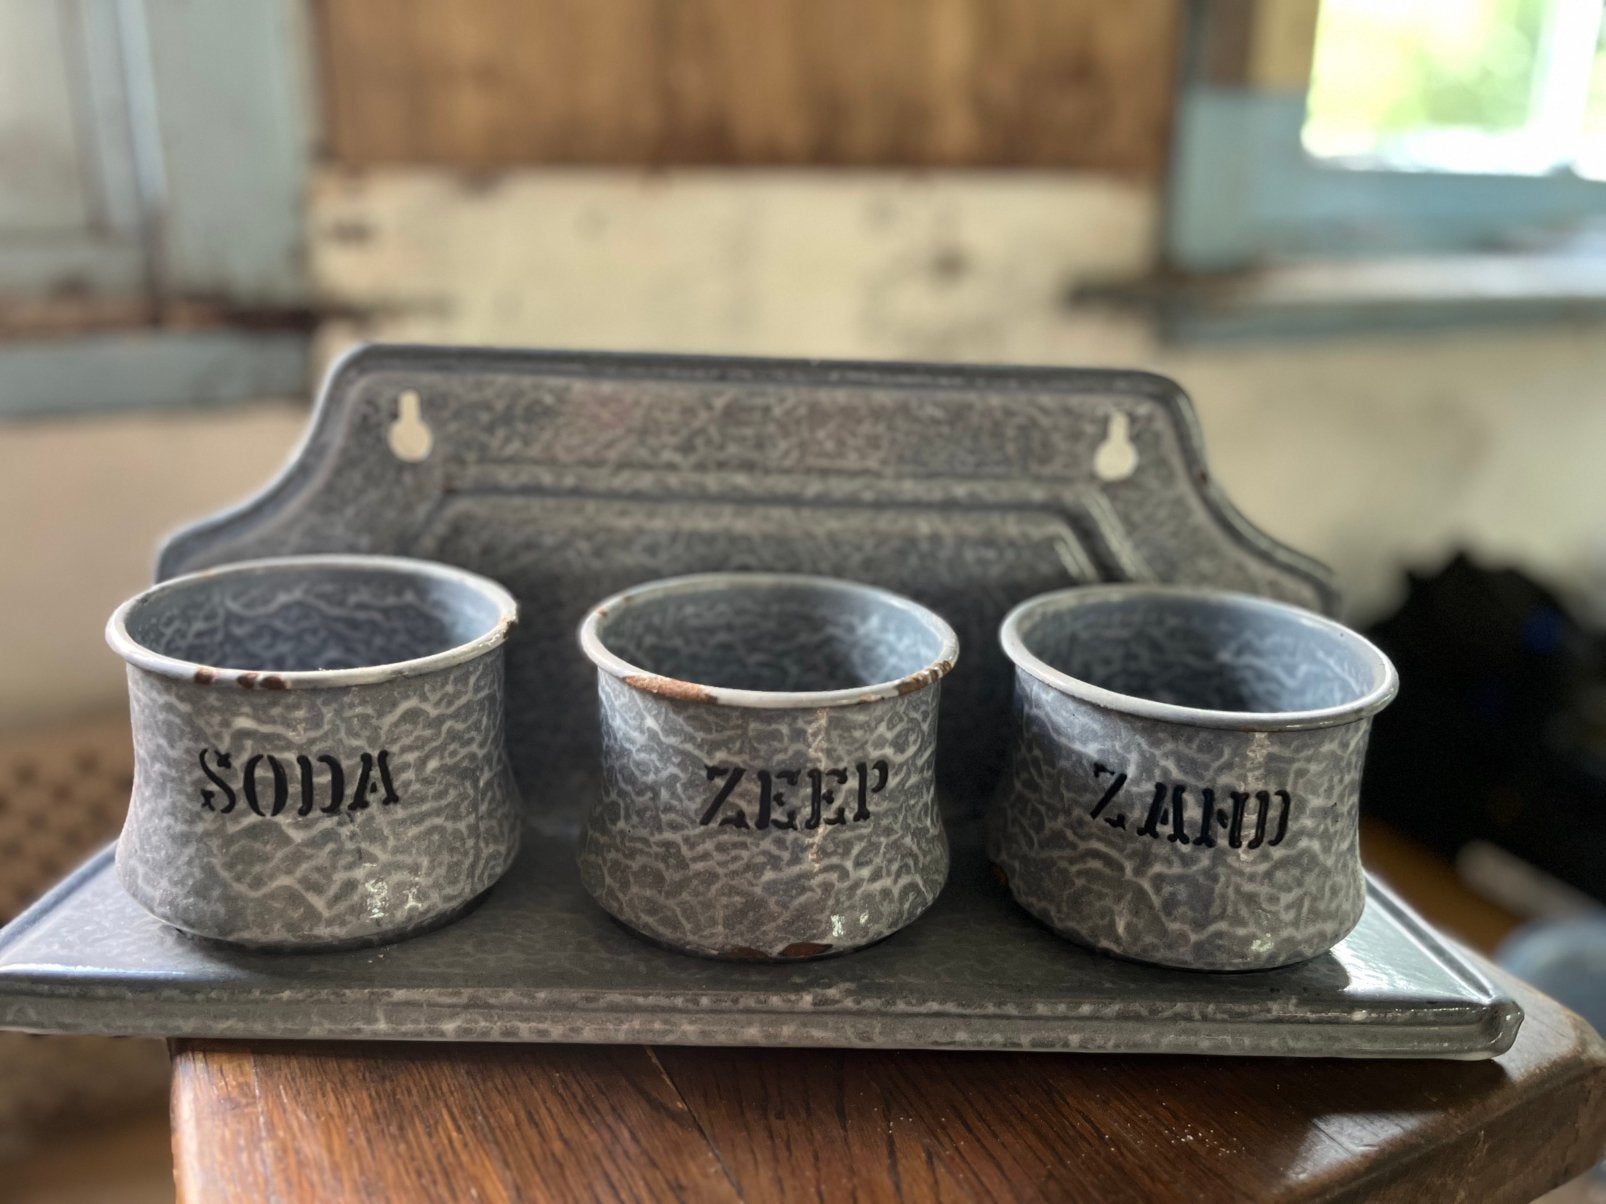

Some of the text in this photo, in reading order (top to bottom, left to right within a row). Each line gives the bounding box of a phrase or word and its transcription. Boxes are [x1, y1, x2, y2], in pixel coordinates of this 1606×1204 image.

[199, 748, 399, 817] SODA
[699, 759, 889, 831] ZEEP
[1089, 762, 1291, 850] ZAND
